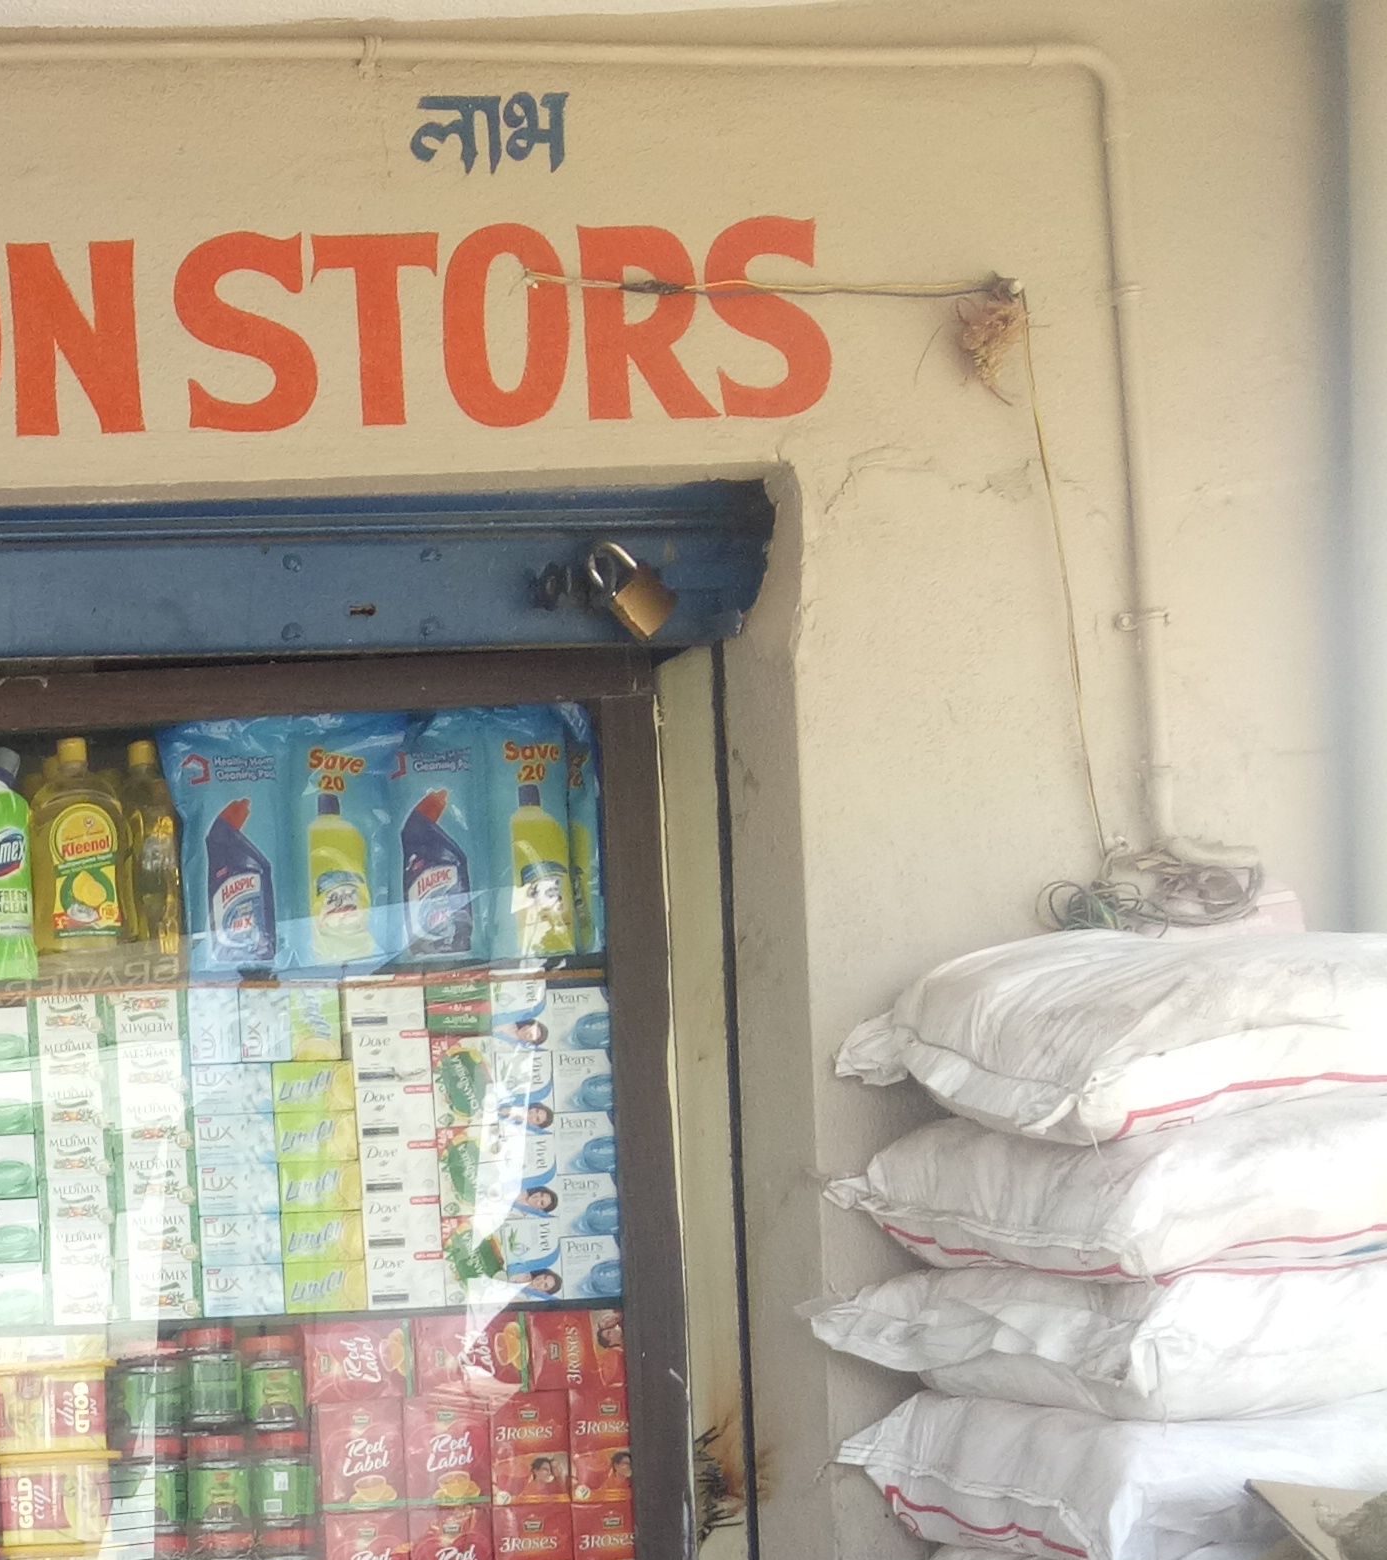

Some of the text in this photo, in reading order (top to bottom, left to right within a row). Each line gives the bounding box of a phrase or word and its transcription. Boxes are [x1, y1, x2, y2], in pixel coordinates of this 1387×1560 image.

[409, 91, 570, 174] लाभ
[174, 215, 832, 433] STORS
[504, 740, 561, 762] Save
[308, 749, 366, 774] Save
[61, 838, 110, 857] Kleenol
[359, 1034, 391, 1048] Dove
[558, 1053, 594, 1067] Pears
[363, 1090, 394, 1103] Dove
[560, 1117, 595, 1129] Pears
[198, 1126, 234, 1141] LUX
[367, 1146, 398, 1159] Dove
[202, 1176, 237, 1191] LUX
[563, 1179, 599, 1192] Pears
[369, 1202, 400, 1215] Dove
[204, 1223, 240, 1238] LUX
[566, 1241, 602, 1254] Pears
[373, 1258, 405, 1270] Dove
[207, 1277, 243, 1292] LUX
[340, 1340, 361, 1380] Red
[359, 1335, 382, 1382] Label
[73, 1381, 89, 1433] GOLD
[342, 1452, 390, 1477] Label
[427, 1447, 473, 1472] Label
[16, 1478, 33, 1528] GOLD
